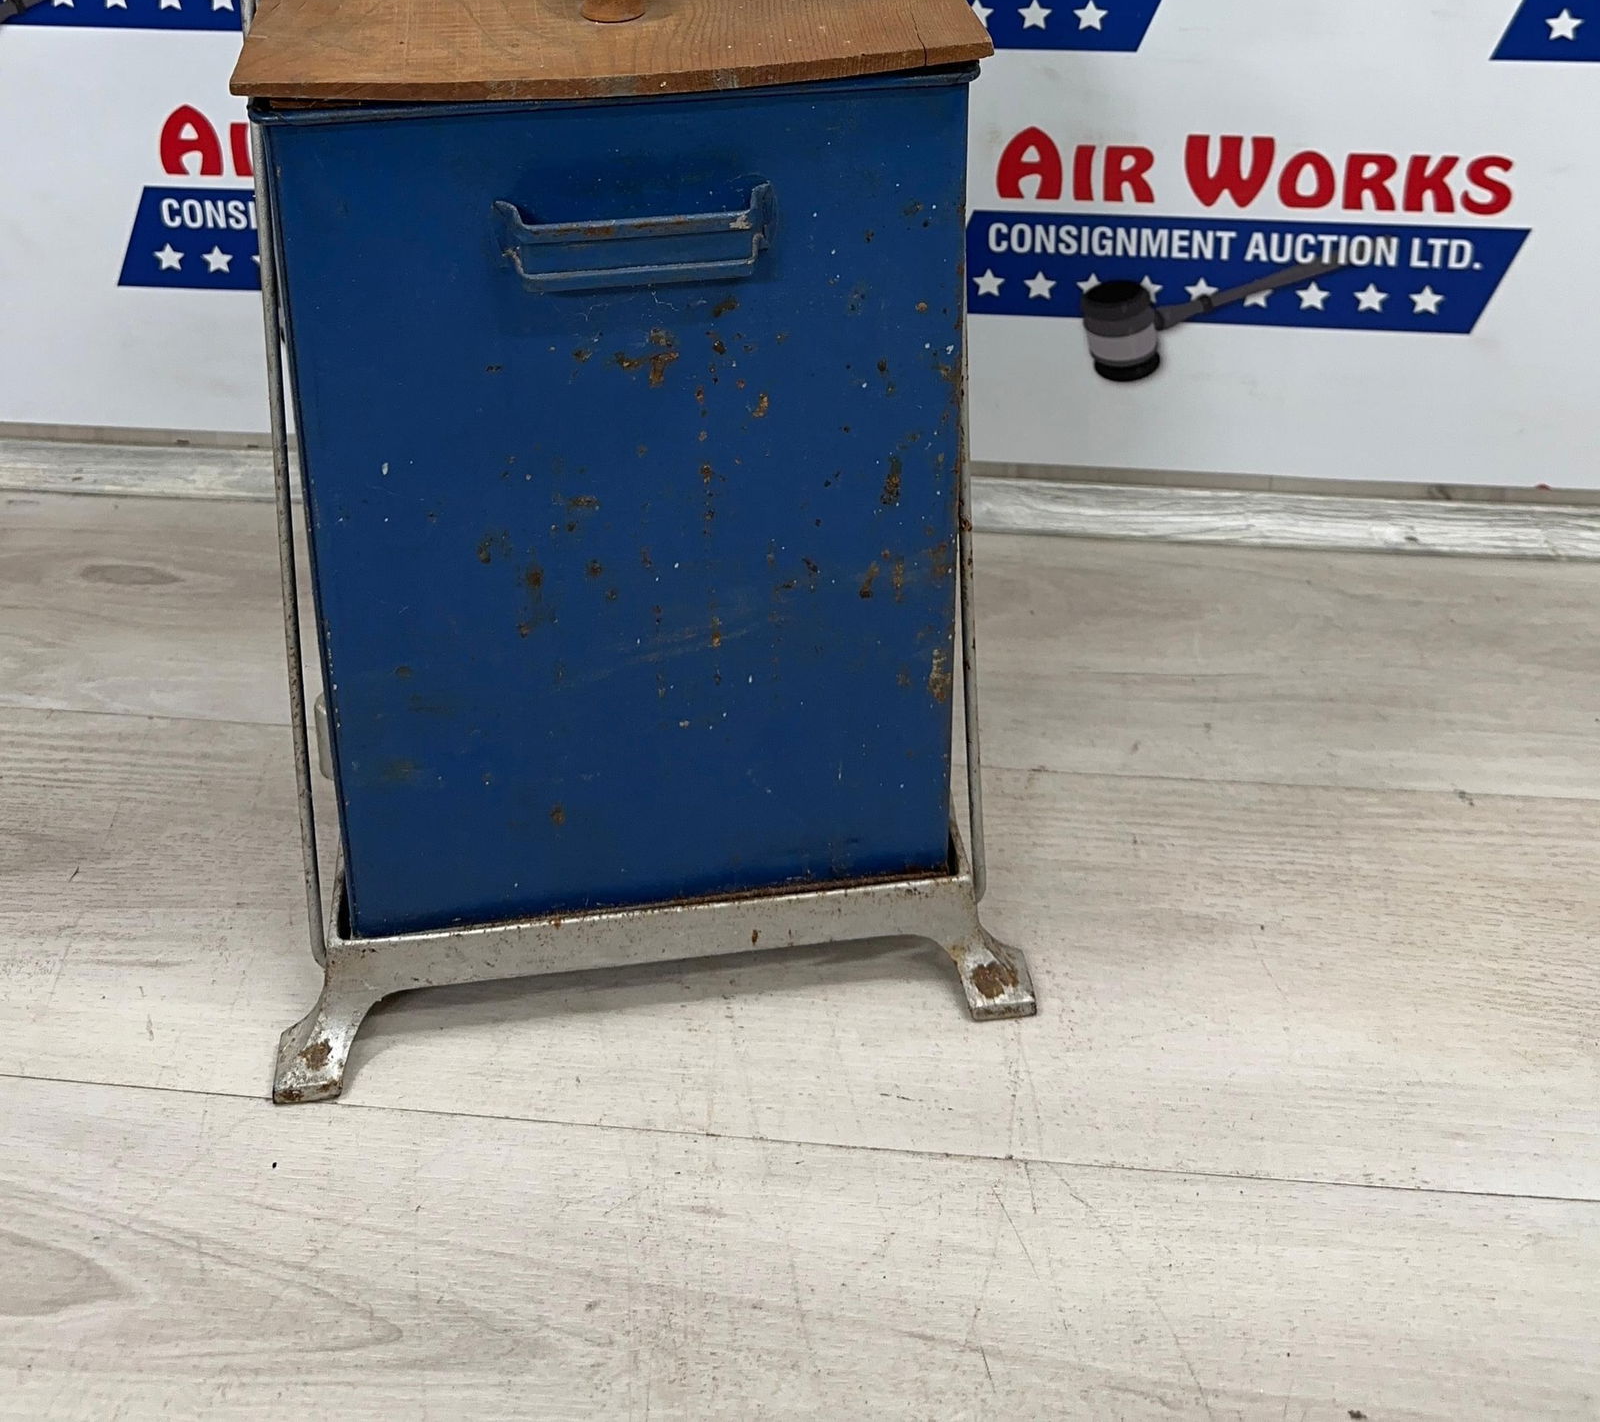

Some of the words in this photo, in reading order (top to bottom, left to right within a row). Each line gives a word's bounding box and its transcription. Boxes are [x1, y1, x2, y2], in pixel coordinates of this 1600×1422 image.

[160, 104, 254, 177] AI
[996, 126, 1155, 203] AIR
[1185, 134, 1514, 216] WORKS
[988, 222, 1236, 260] CONSIGNMENT
[1244, 231, 1398, 267] AUCTION
[1409, 238, 1483, 271] LTD.
